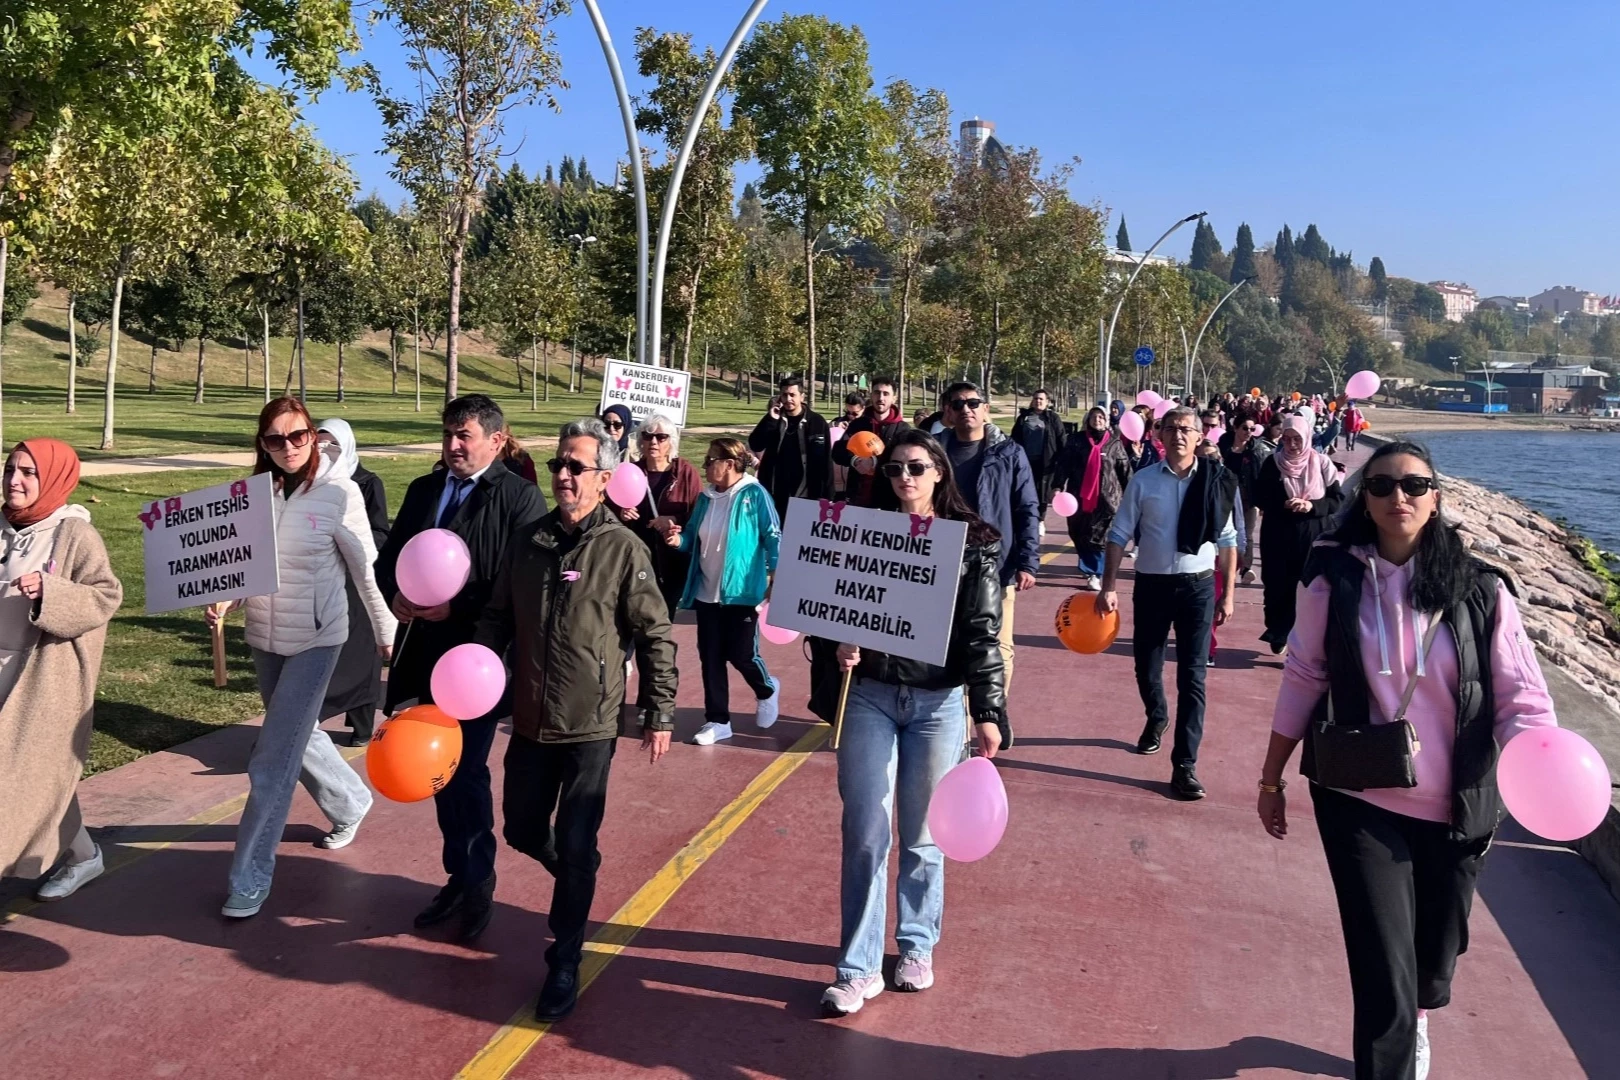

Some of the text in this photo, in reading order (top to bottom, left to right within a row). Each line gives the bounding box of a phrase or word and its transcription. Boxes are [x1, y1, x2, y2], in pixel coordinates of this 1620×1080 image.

[622, 368, 674, 384] KANSERDEN
[634, 382, 659, 393] DEĞİL
[609, 390, 681, 408] GEÇ KALMAKTAN
[165, 493, 249, 528] ERKEN TEŞHİS
[179, 523, 238, 549] YOLUNDA
[810, 521, 933, 556] KENDİ KENDİNE
[168, 545, 252, 576] TARANMAYAN
[798, 545, 937, 586] MEME MUAYENESİ
[178, 572, 245, 599] KALMASIN!
[835, 579, 887, 604] HAYAT
[797, 598, 915, 640] KURTARABİLİR.
